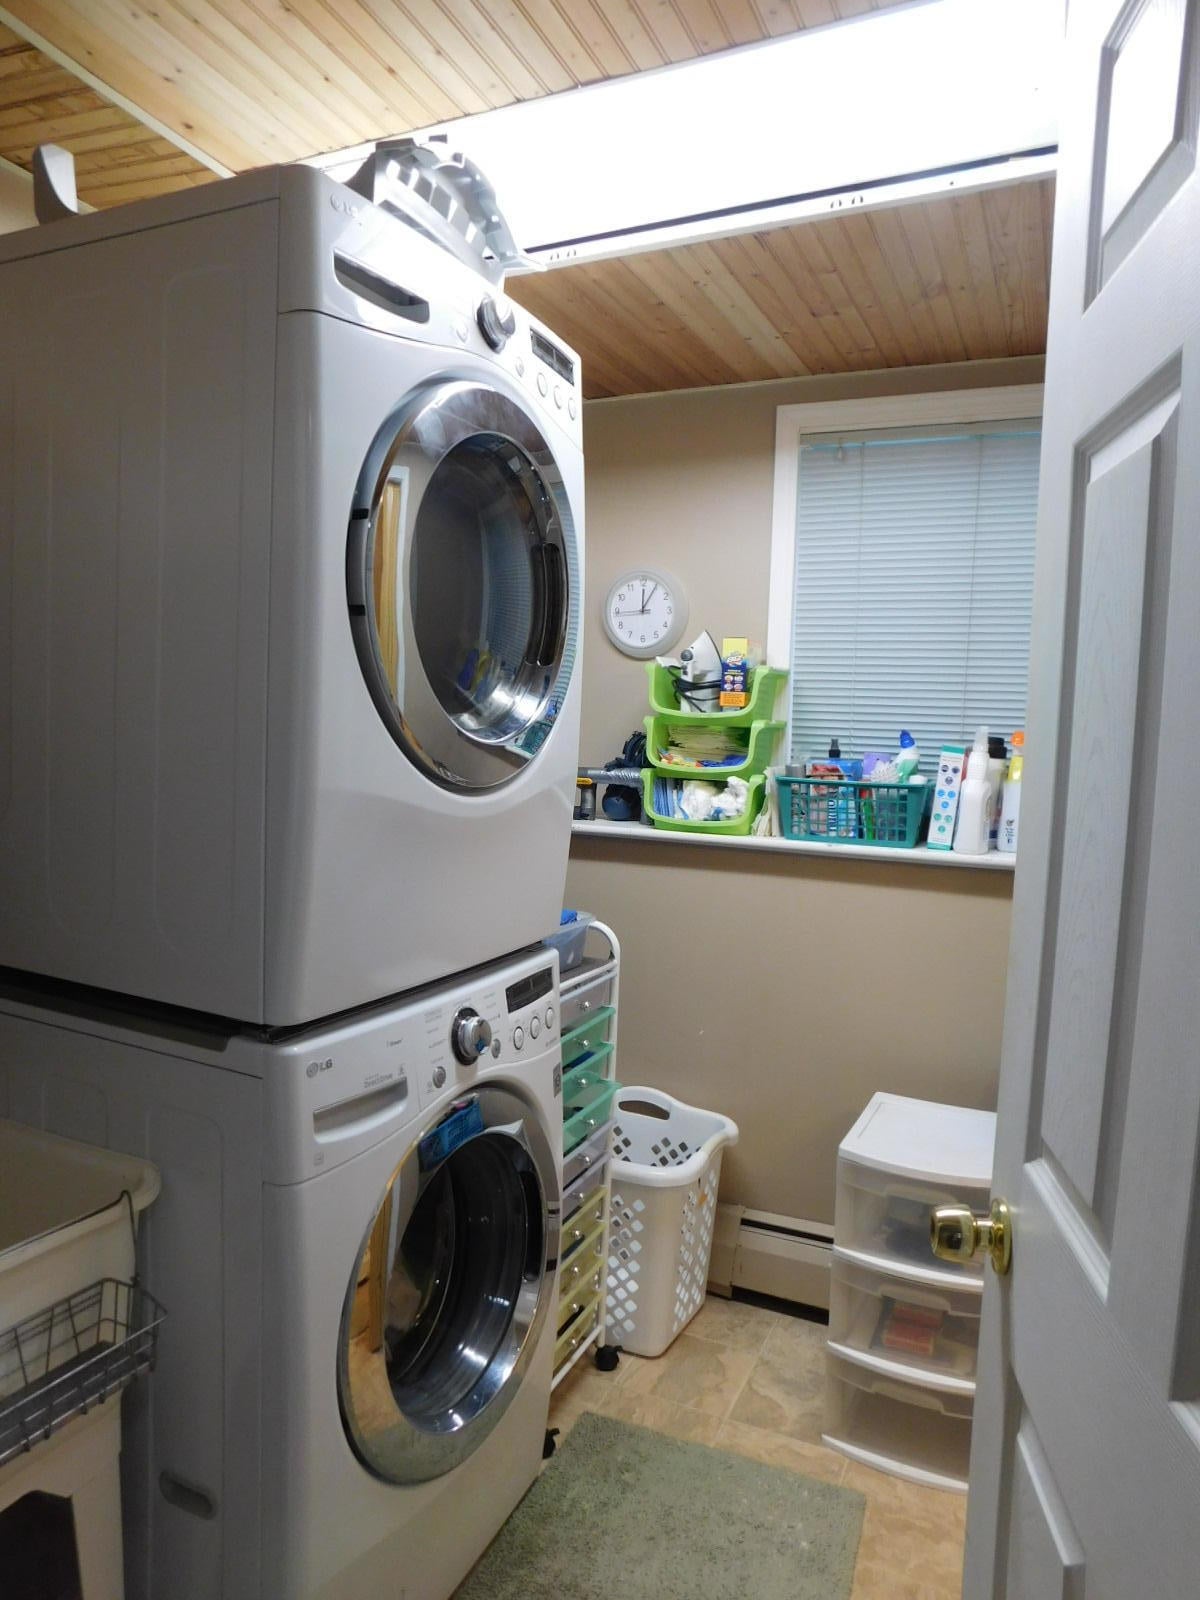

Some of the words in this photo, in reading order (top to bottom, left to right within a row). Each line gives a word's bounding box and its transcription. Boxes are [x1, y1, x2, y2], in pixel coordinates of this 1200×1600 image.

[627, 583, 634, 592] 11
[617, 593, 626, 602] 10
[663, 592, 669, 601] 2
[666, 605, 673, 615] 3
[618, 621, 624, 630] 8
[627, 630, 633, 639] 7
[640, 634, 646, 643] 6
[653, 631, 659, 639] 5
[319, 1058, 333, 1072] LG
